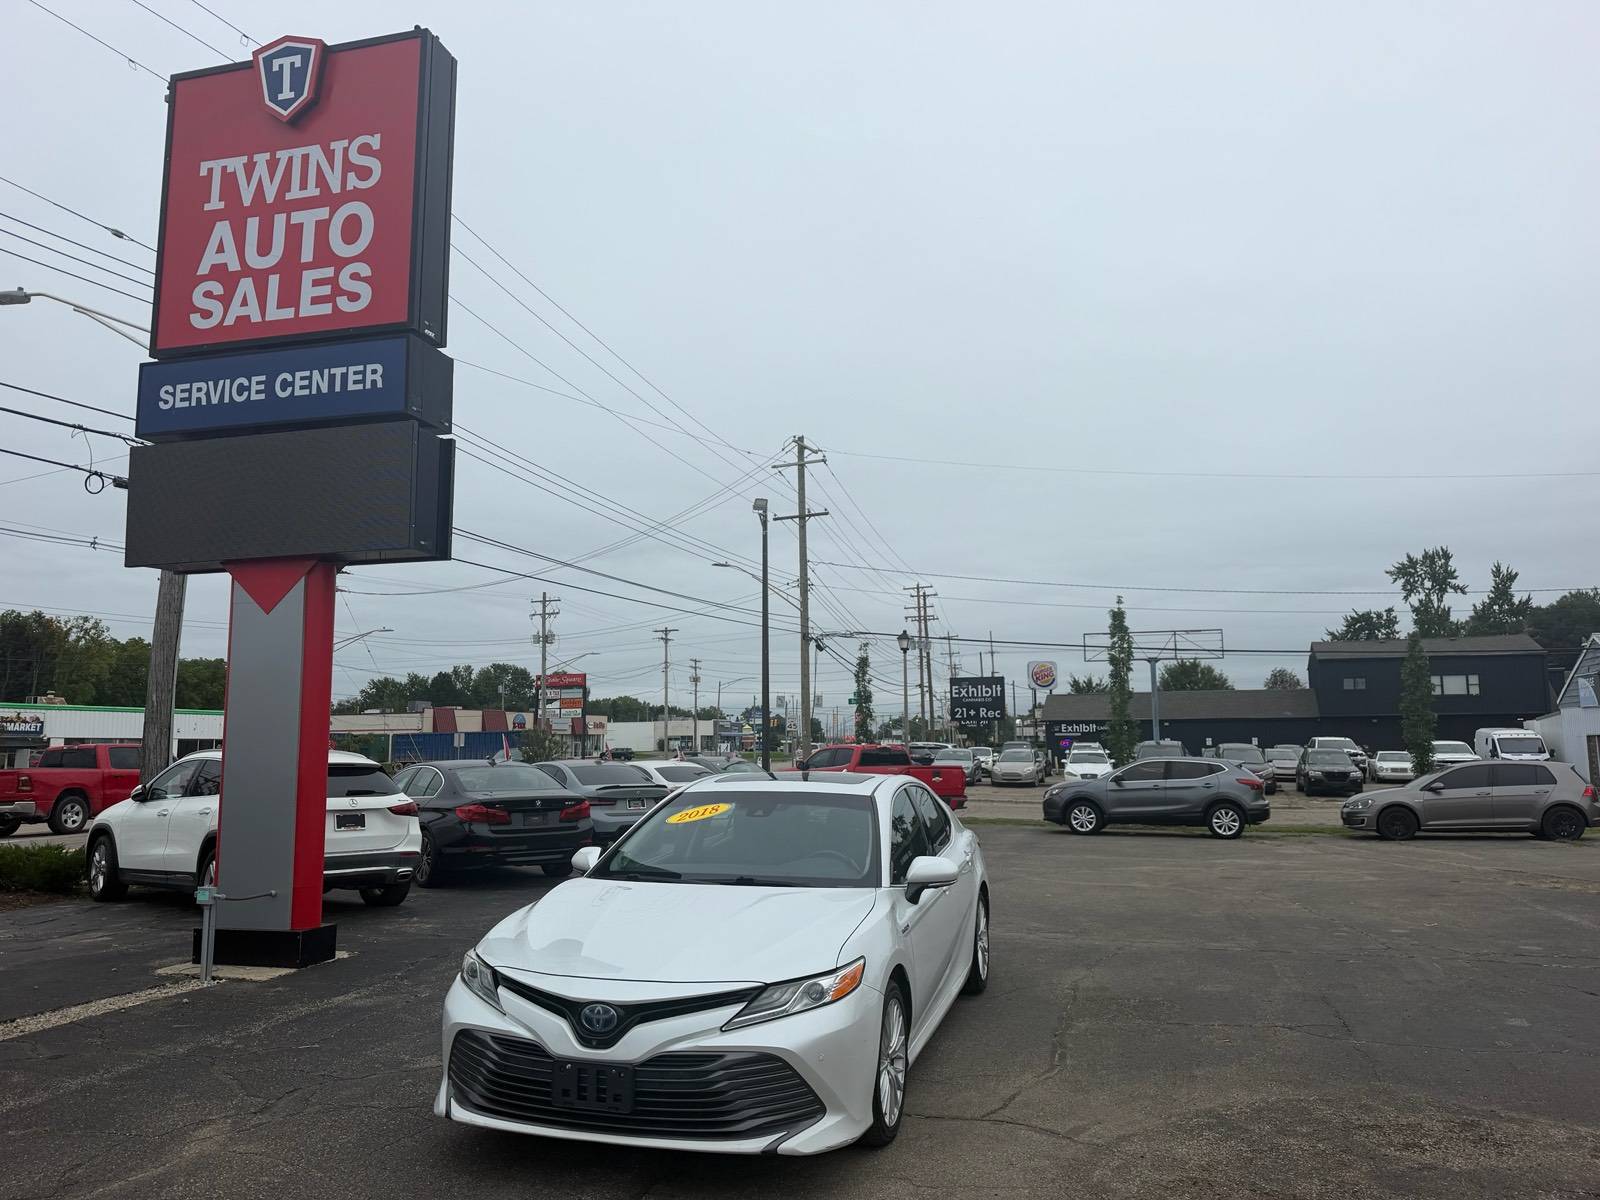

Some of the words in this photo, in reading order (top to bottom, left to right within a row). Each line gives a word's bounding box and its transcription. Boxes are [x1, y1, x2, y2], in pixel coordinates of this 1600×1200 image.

[271, 54, 301, 101] T
[199, 133, 382, 211] TWINS
[196, 201, 375, 275] AUTO
[189, 262, 373, 329] SALES
[158, 376, 266, 411] SERVICE
[274, 363, 384, 398] CENTER
[1035, 670, 1055, 682] KING
[951, 684, 1002, 698] Exhibit
[954, 707, 976, 718] 21+
[979, 707, 1001, 718] Rec
[787, 722, 798, 730] 45
[1061, 723, 1097, 733] Exhibit
[676, 804, 721, 822] 2018
